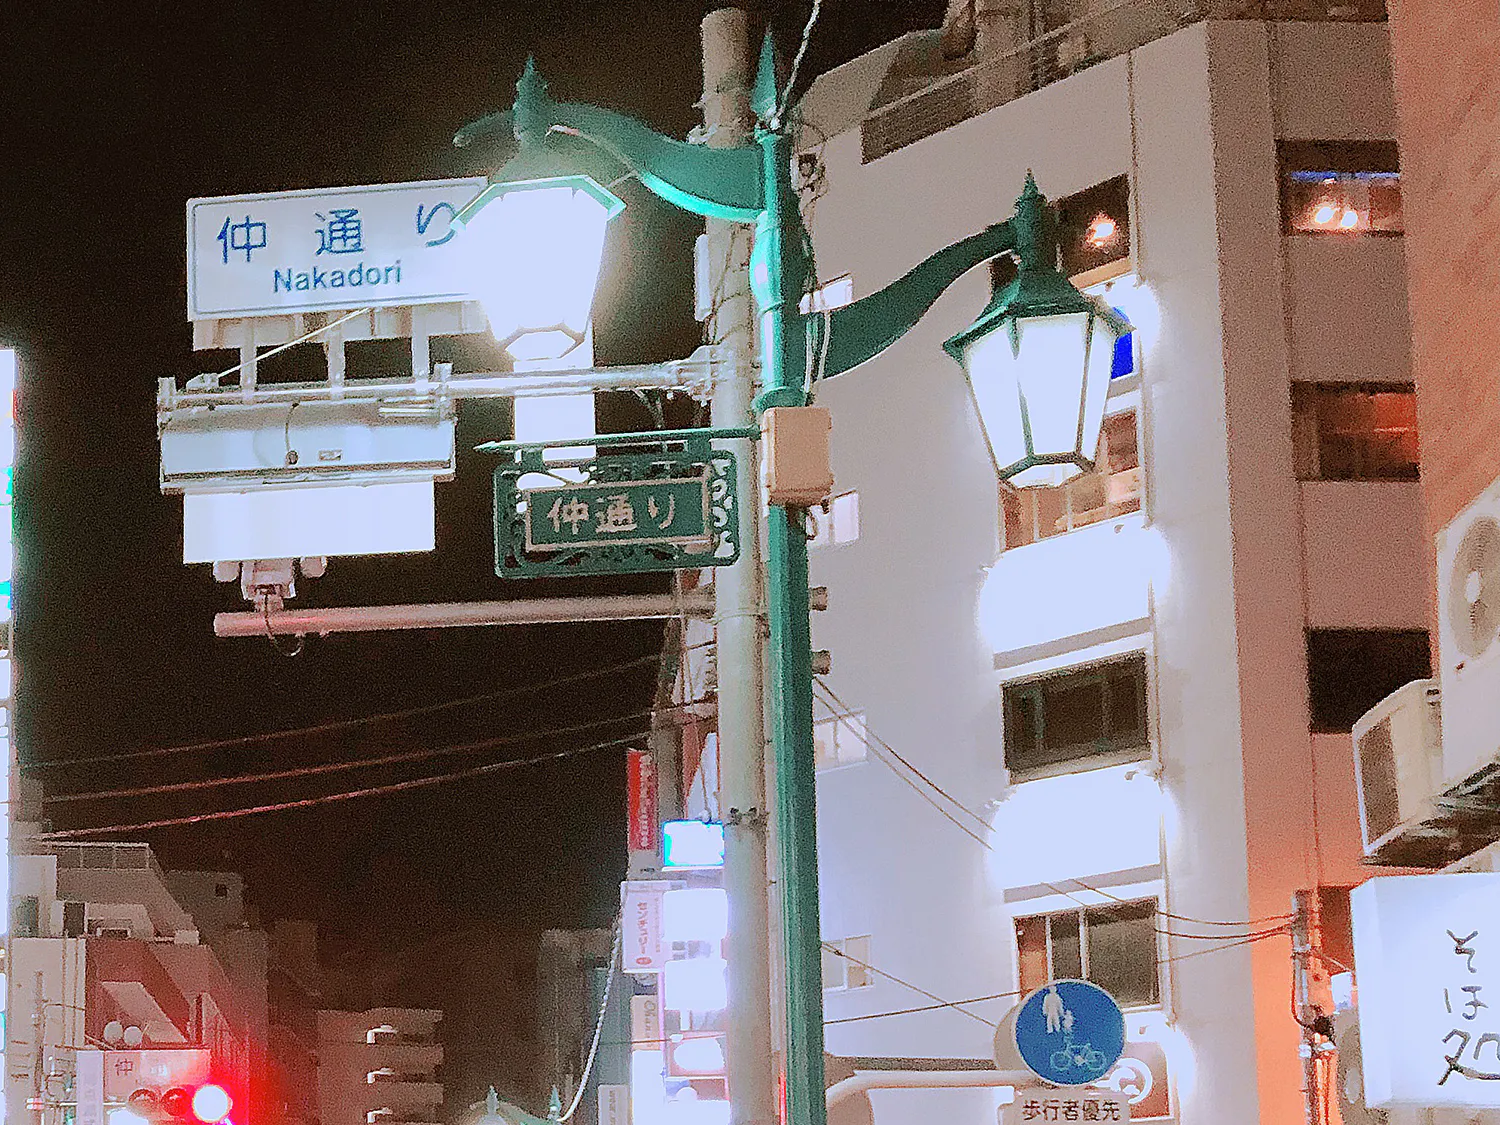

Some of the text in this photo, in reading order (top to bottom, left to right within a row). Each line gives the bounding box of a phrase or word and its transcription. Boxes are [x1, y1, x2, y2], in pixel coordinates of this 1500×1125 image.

[216, 201, 458, 264] 仲通り
[273, 259, 402, 293] Nakadori
[547, 493, 675, 535] 仲通り
[1022, 1099, 1120, 1122] 歩行者優先
